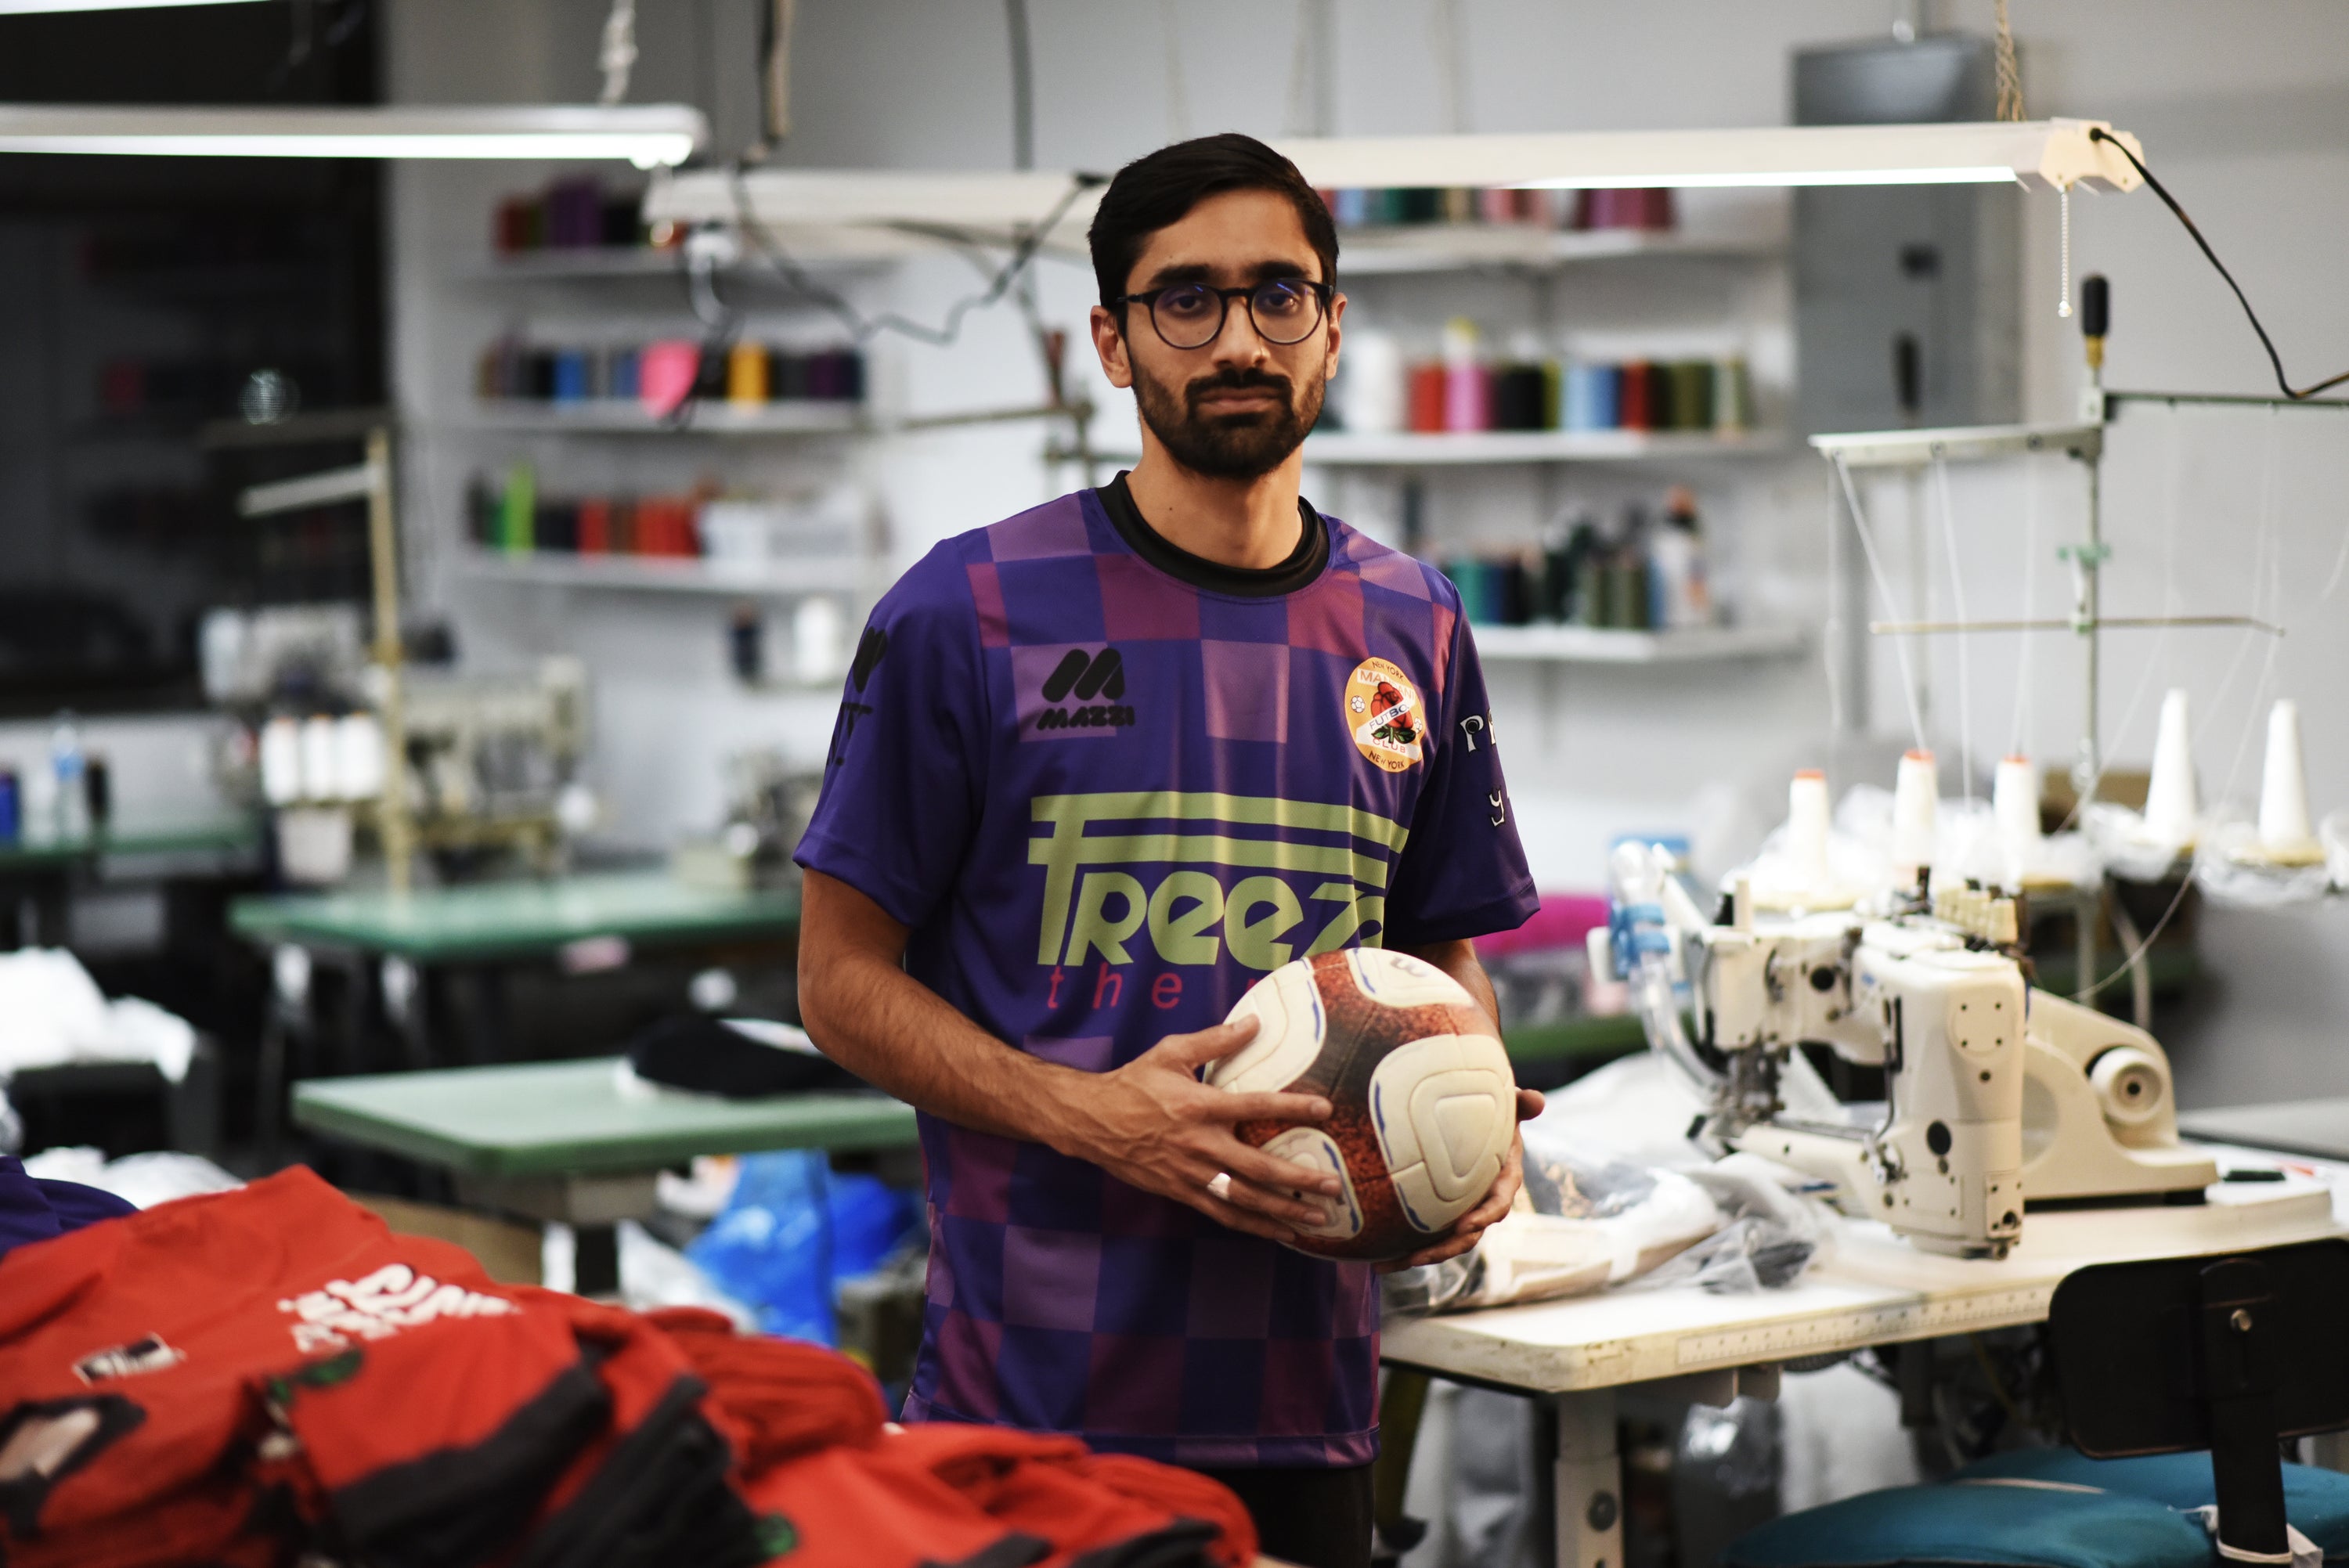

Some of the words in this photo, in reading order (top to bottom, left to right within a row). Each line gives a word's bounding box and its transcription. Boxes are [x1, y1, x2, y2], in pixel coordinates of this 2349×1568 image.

[1386, 665, 1404, 681] YORK
[1369, 704, 1410, 730] FUTBO
[1373, 736, 1405, 753] CLUB
[1369, 751, 1386, 765] NEW
[1387, 759, 1404, 770] YORK
[1047, 961, 1183, 1009] the
